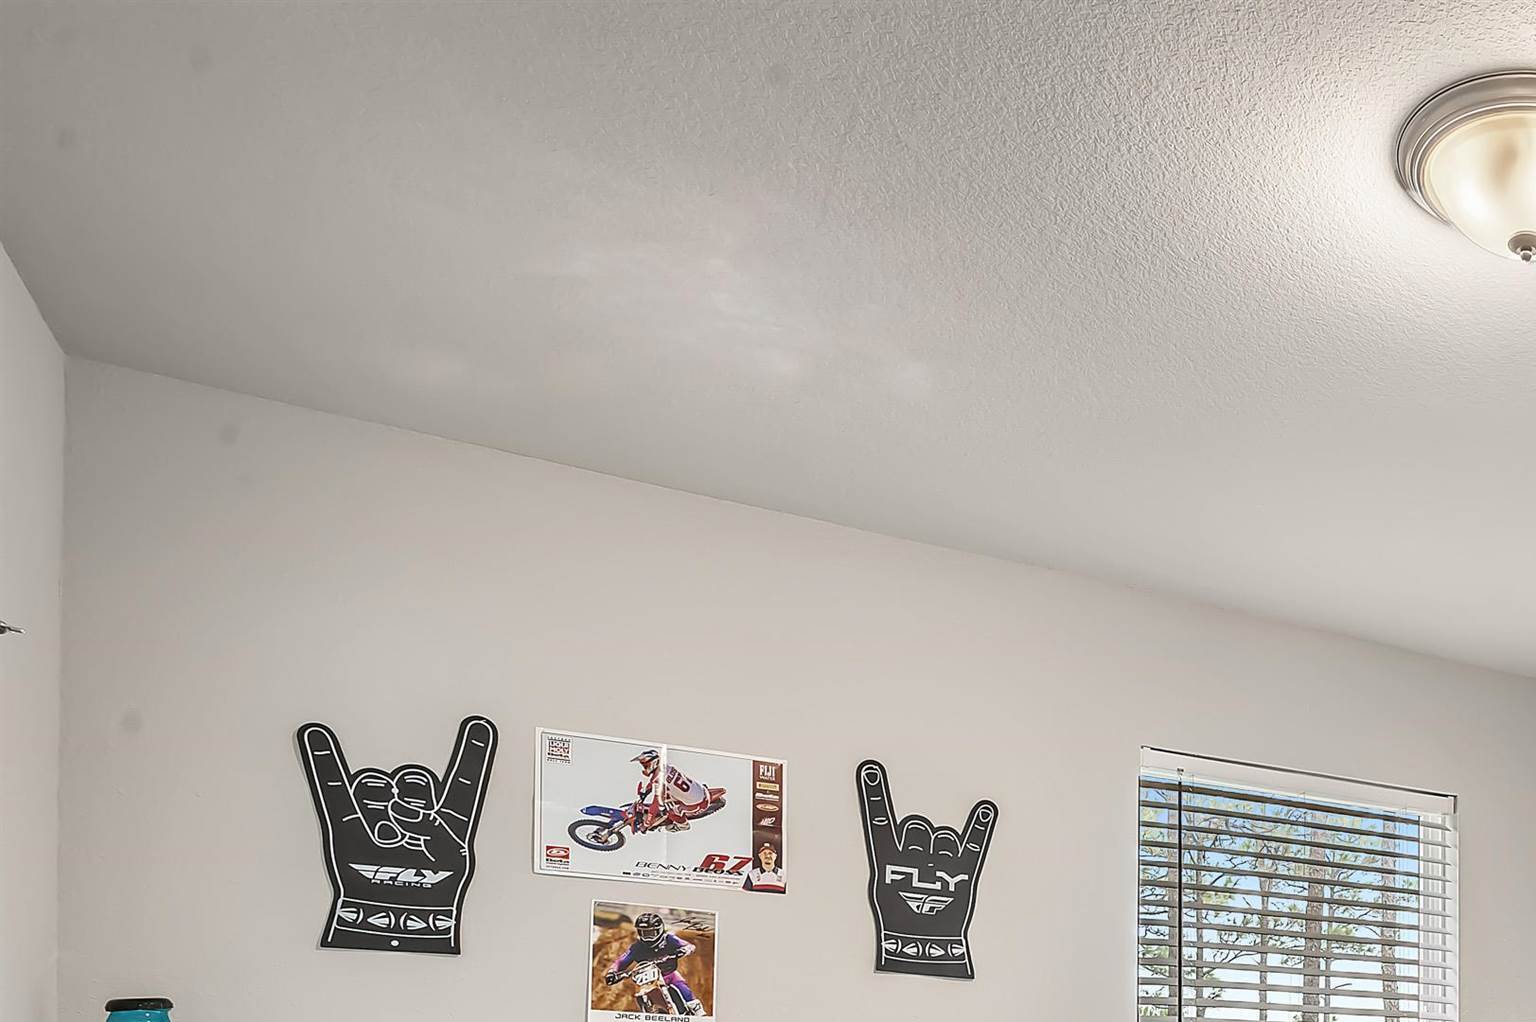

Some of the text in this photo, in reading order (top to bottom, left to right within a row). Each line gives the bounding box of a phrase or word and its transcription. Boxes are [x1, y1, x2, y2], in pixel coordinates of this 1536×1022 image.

[635, 861, 687, 871] BENNY
[700, 854, 752, 872] 67
[885, 865, 969, 891] FLY
[371, 879, 432, 888] RACING
[644, 1014, 690, 1022] BEELAND
